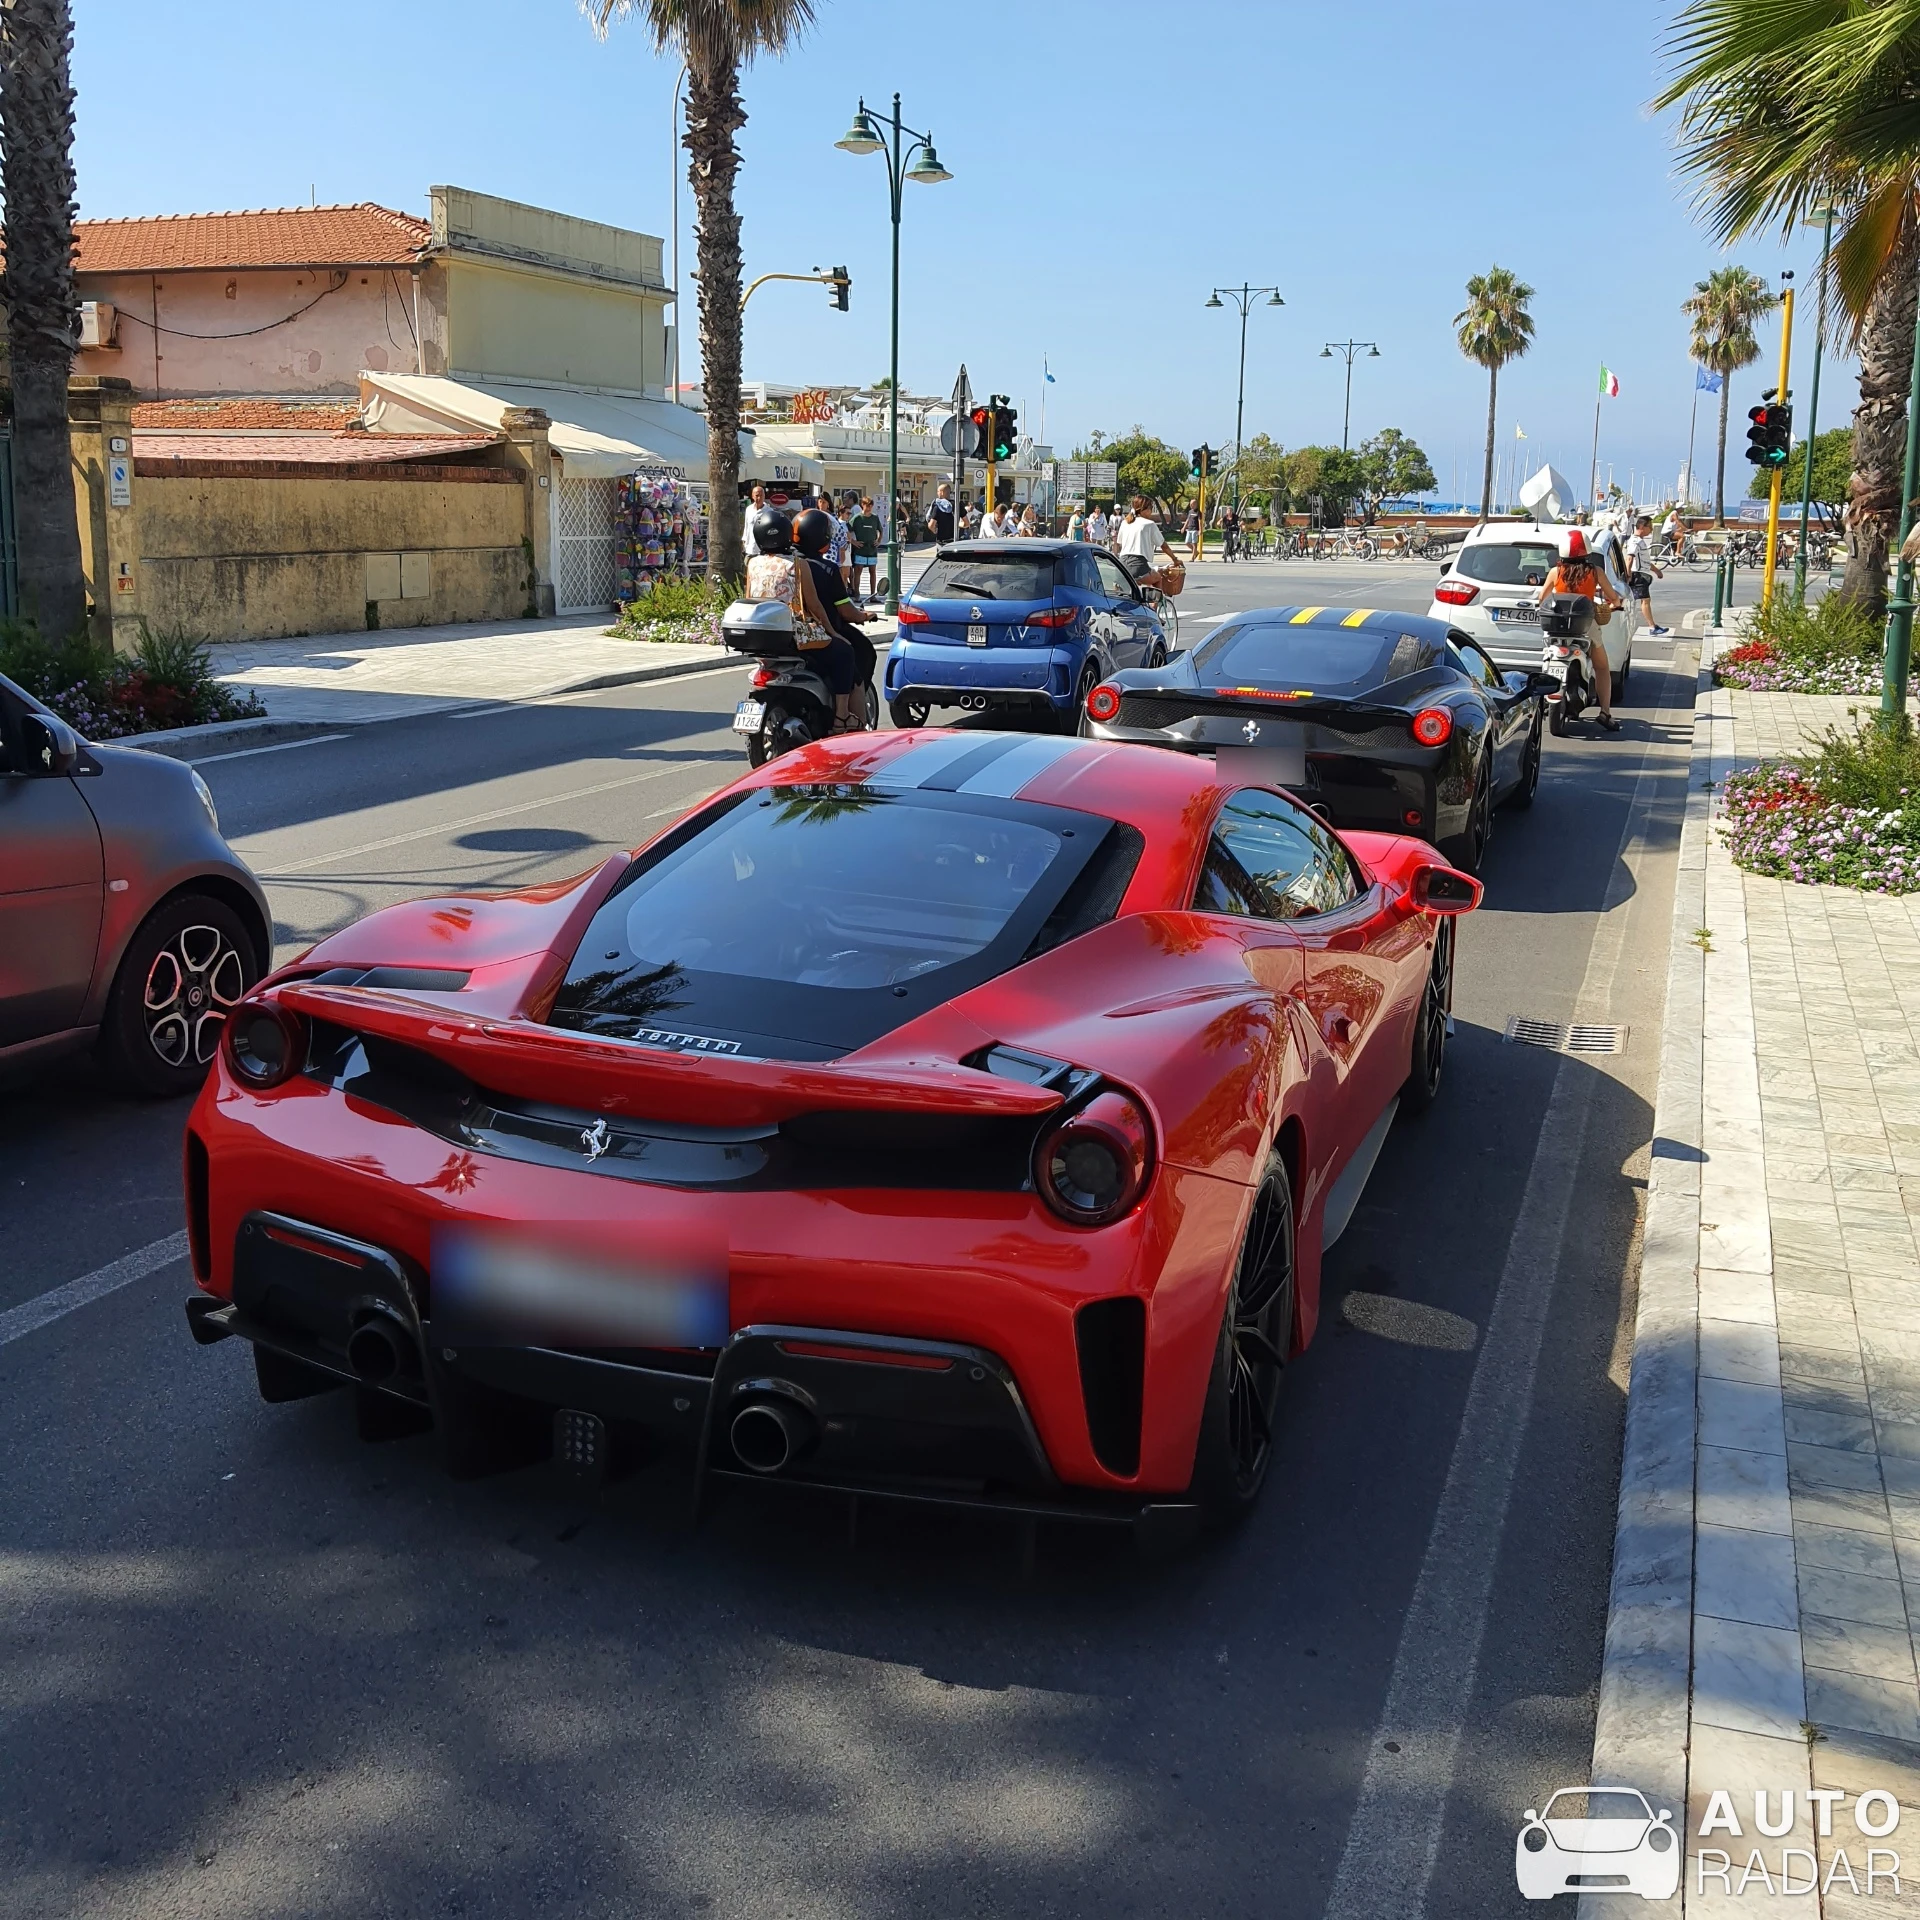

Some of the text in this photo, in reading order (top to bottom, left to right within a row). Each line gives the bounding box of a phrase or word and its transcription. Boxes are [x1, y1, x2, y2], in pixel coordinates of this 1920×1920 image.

[794, 390, 830, 410] PESCE
[1500, 610, 1512, 620] EX
[1004, 626, 1029, 642] AV
[632, 1028, 742, 1054] Ferrari
